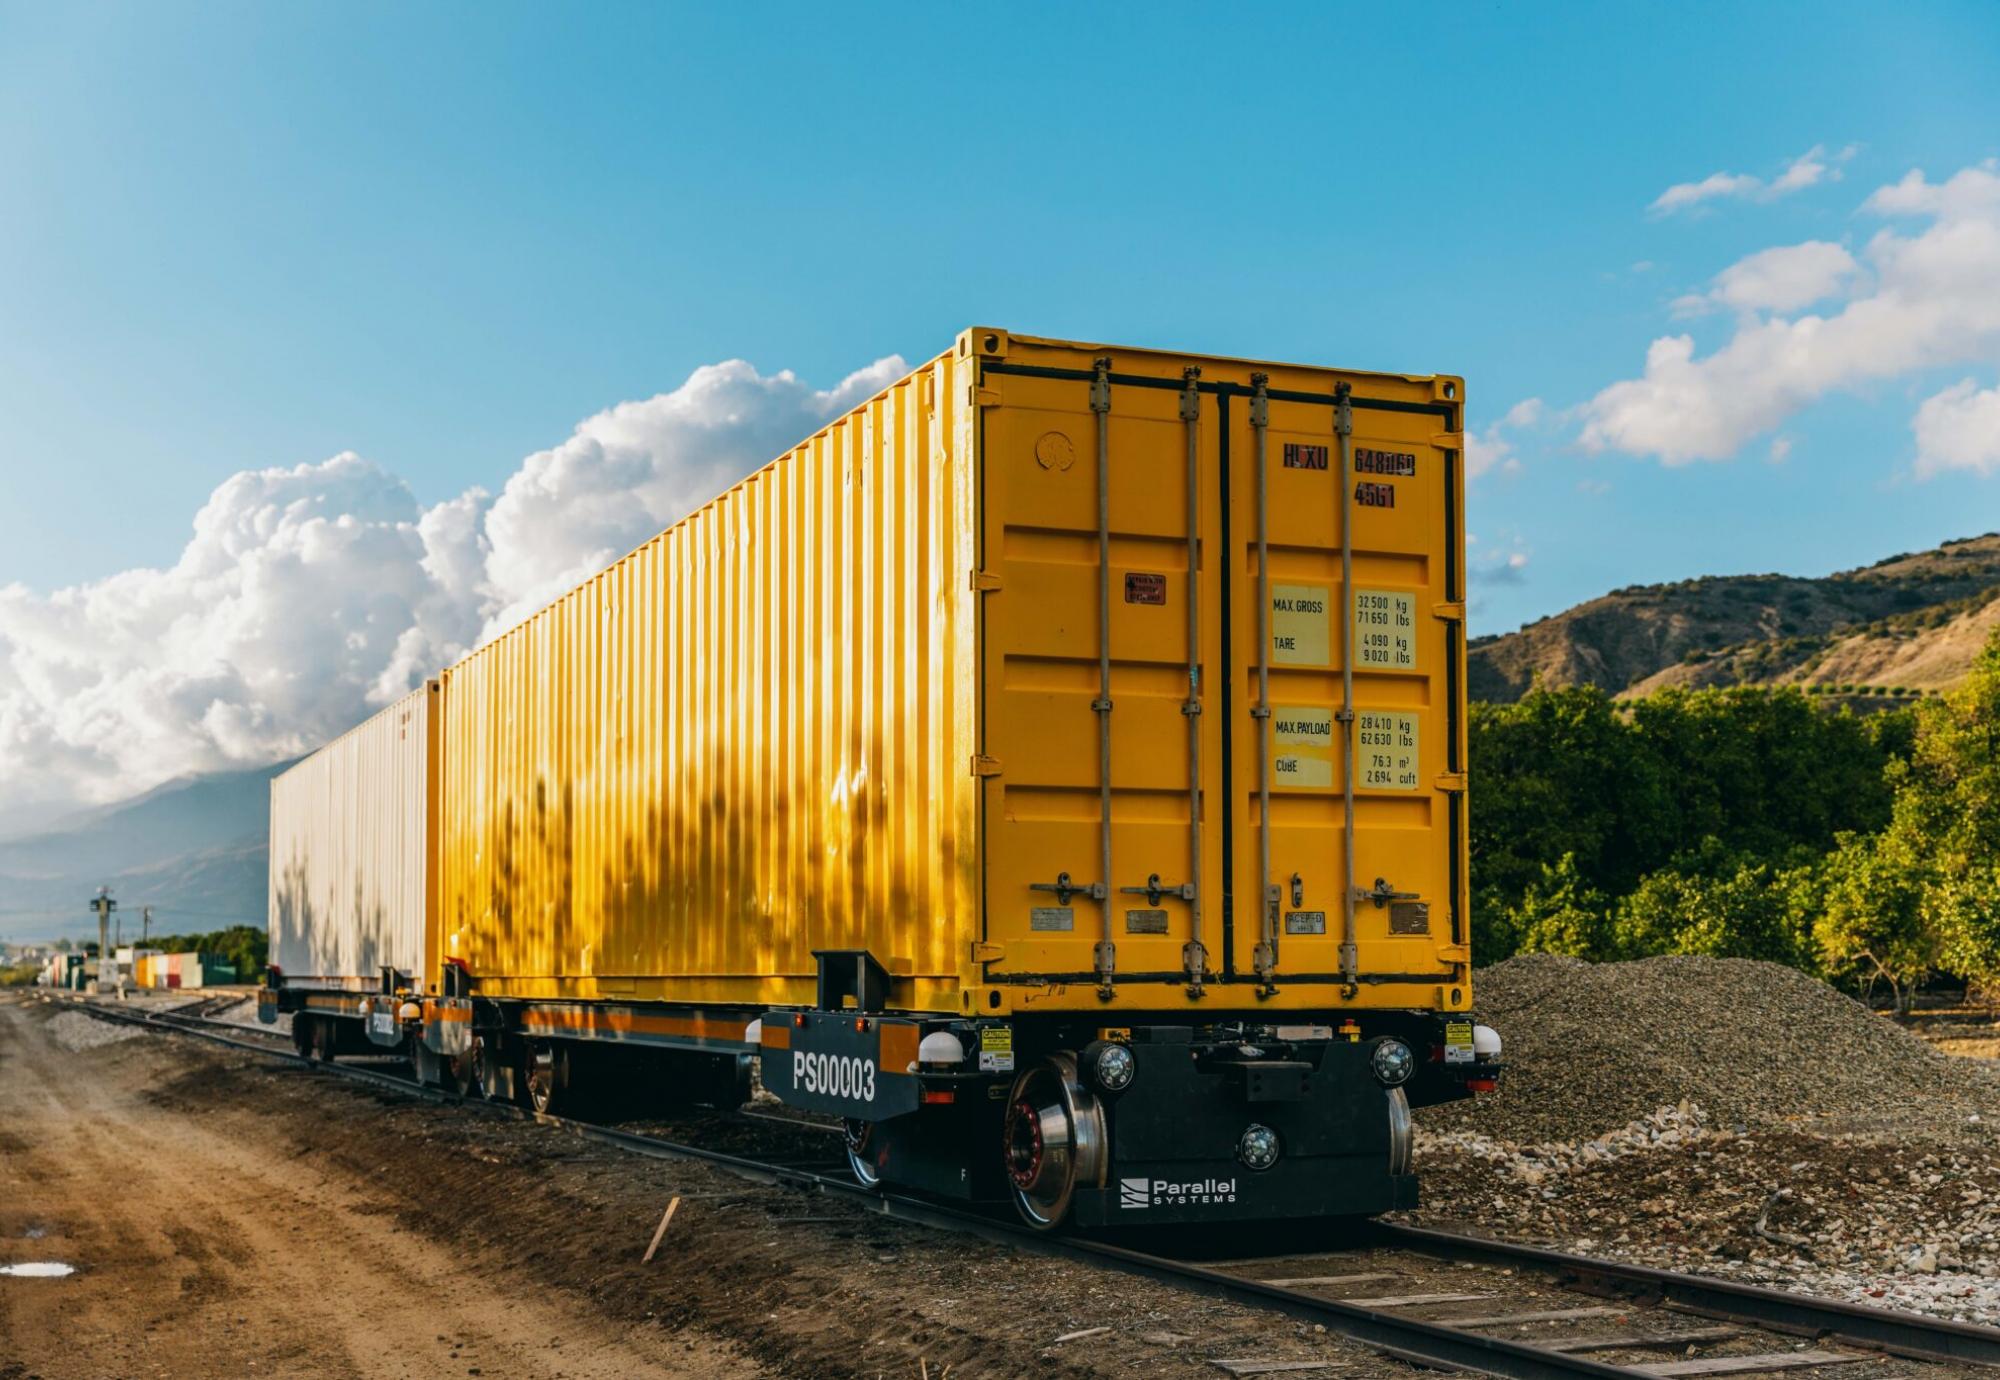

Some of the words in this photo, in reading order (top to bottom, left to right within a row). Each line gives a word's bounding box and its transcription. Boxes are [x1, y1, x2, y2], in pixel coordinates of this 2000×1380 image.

[1283, 443, 1328, 470] HLXU
[1354, 482, 1395, 508] 45G1
[1396, 598, 1407, 614] kg
[1396, 615, 1410, 627] lbs
[1273, 636, 1295, 650] TARE
[1396, 636, 1407, 652] kg
[1396, 651, 1410, 664] lbs
[1400, 718, 1410, 734] kg
[1400, 734, 1413, 747] lbs
[1276, 759, 1297, 773] CUBE
[794, 1051, 875, 1102] PS00003
[1153, 1178, 1236, 1195] Parallel
[1153, 1195, 1236, 1205] SYSTEMS
